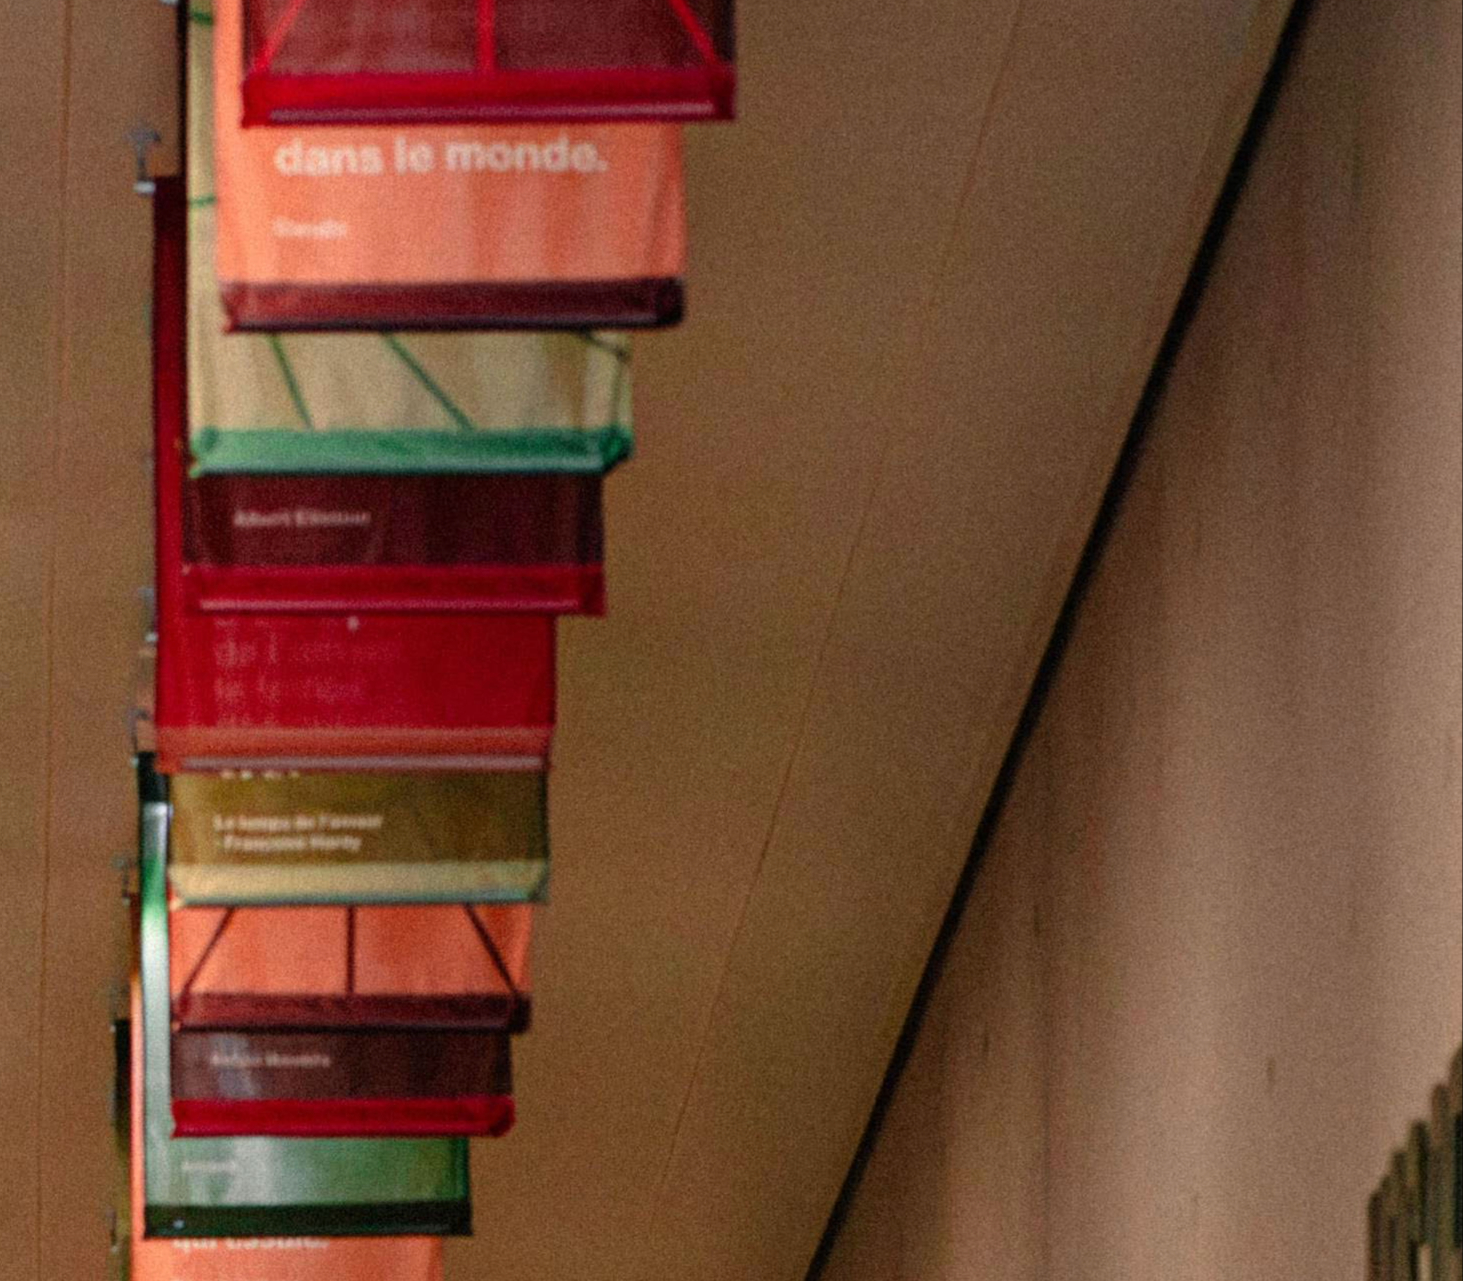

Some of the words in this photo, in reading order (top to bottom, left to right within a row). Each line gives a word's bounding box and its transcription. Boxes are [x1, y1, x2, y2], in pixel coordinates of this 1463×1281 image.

[274, 136, 383, 176] dans
[394, 136, 435, 174] le
[446, 135, 608, 173] monde.
